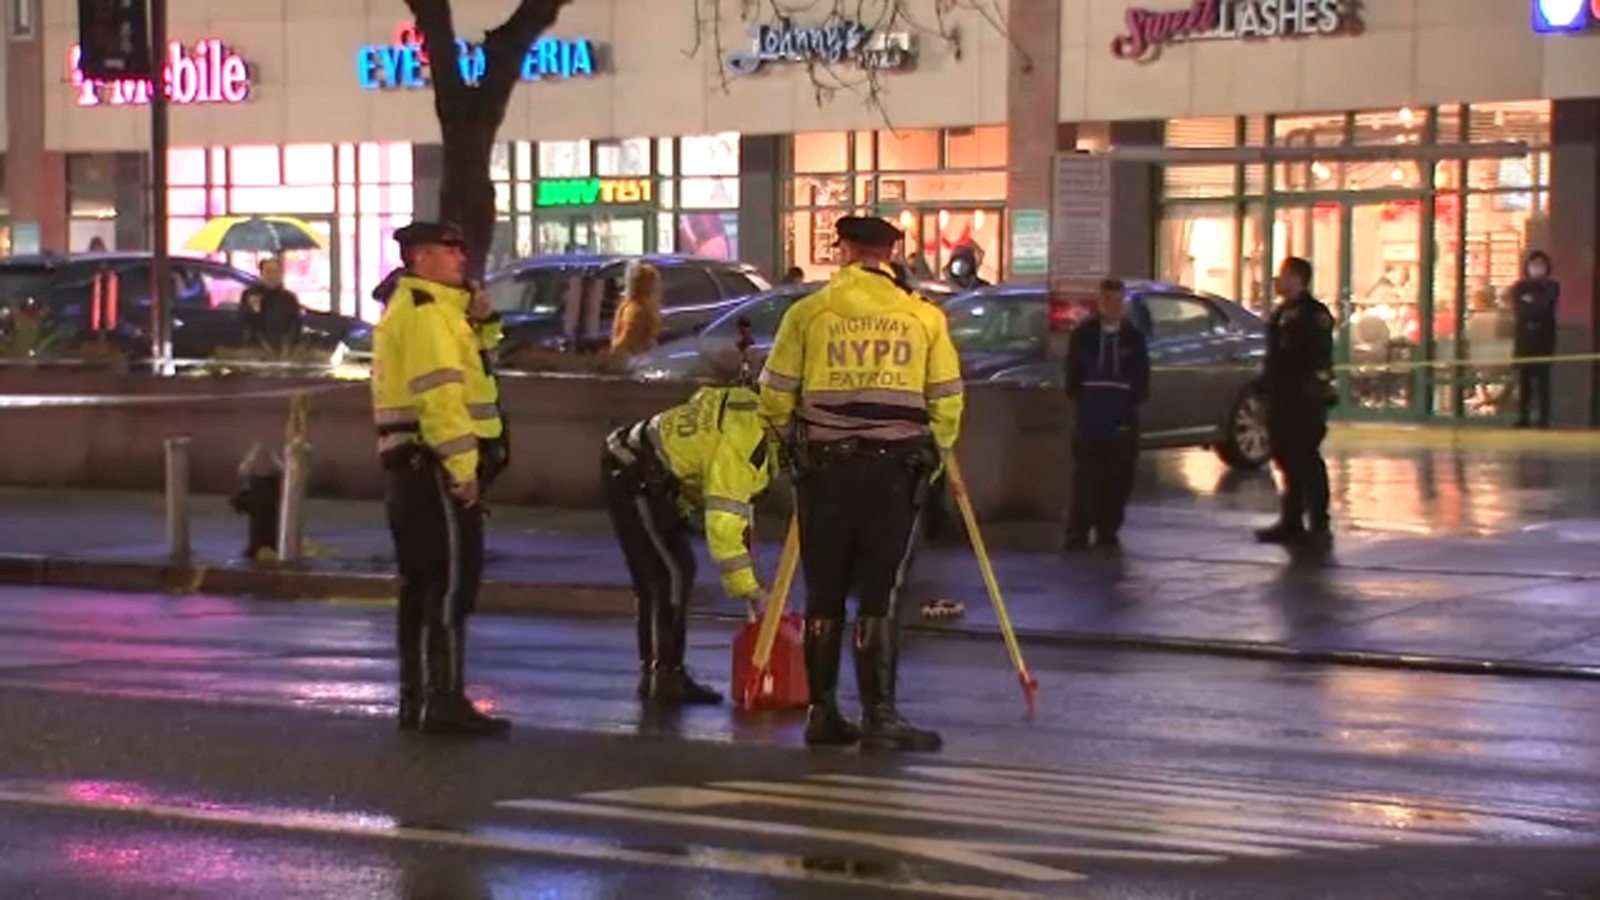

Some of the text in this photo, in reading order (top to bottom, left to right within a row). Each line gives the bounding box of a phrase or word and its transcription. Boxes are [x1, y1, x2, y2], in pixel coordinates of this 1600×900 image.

[1216, 0, 1338, 36] LASHES
[358, 43, 426, 90] EYE
[829, 315, 911, 337] HIGHWAY
[827, 339, 912, 367] NYPD
[829, 371, 908, 388] PATROL
